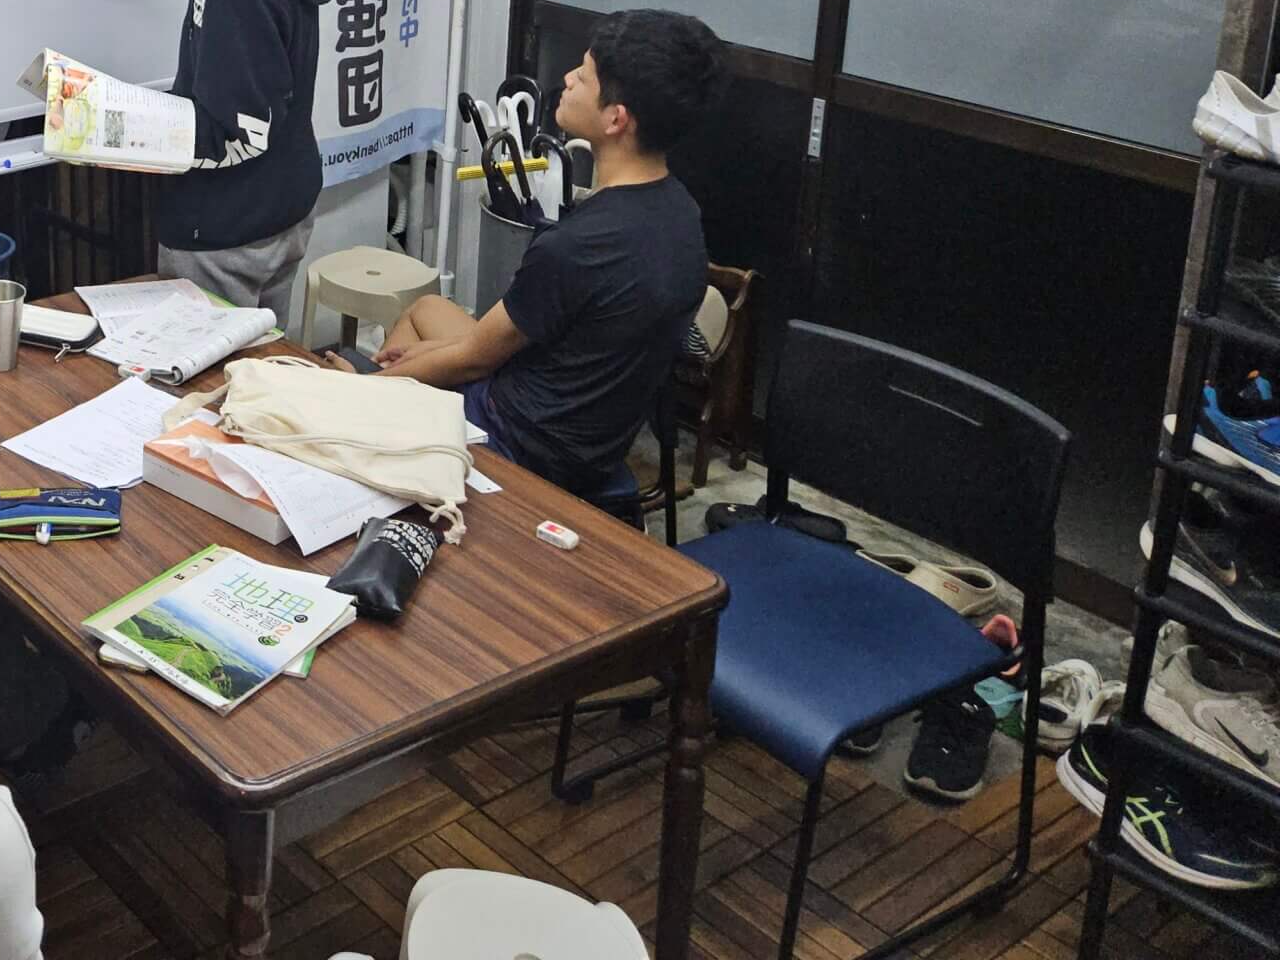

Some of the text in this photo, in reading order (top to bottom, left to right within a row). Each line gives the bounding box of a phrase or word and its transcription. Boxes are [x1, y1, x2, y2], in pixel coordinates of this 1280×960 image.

[207, 588, 283, 631] 完全学習
[222, 572, 315, 624] 地理
